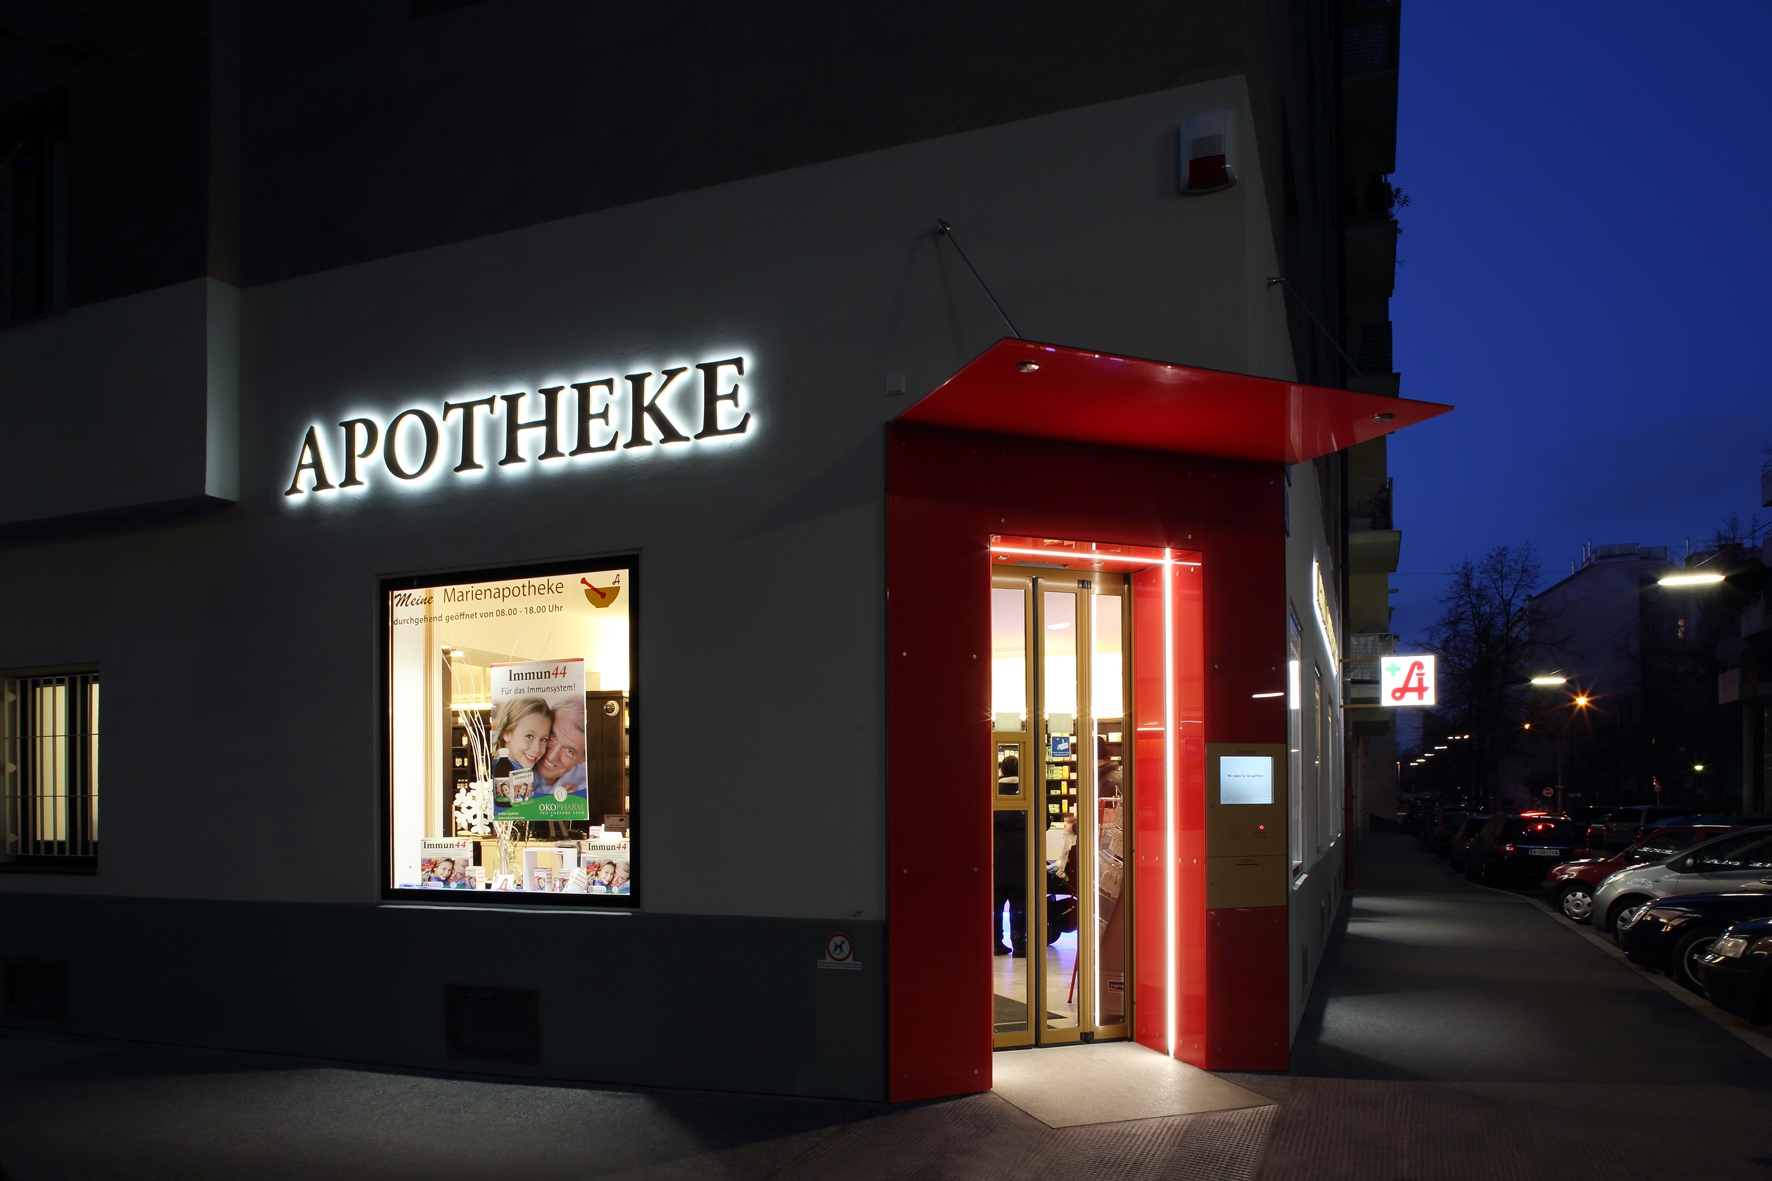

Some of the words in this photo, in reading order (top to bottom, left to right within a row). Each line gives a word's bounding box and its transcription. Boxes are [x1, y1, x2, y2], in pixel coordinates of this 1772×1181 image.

[284, 356, 751, 496] APOTHEKE
[394, 592, 434, 608] Meine
[443, 579, 564, 604] Marienapotheke
[393, 613, 443, 626] durchgehend
[445, 611, 478, 623] geöffnet
[479, 610, 494, 618] von
[495, 607, 518, 617] 08.00
[525, 605, 546, 615] 18.00
[548, 603, 563, 613] Uhr
[508, 665, 568, 682] Immun44
[501, 687, 512, 695] Für
[514, 686, 525, 694] das
[527, 683, 576, 694] Immunsystem!
[538, 803, 585, 812] ÖKOPHARM
[423, 841, 467, 849] Immun44
[588, 843, 627, 851] Immun44
